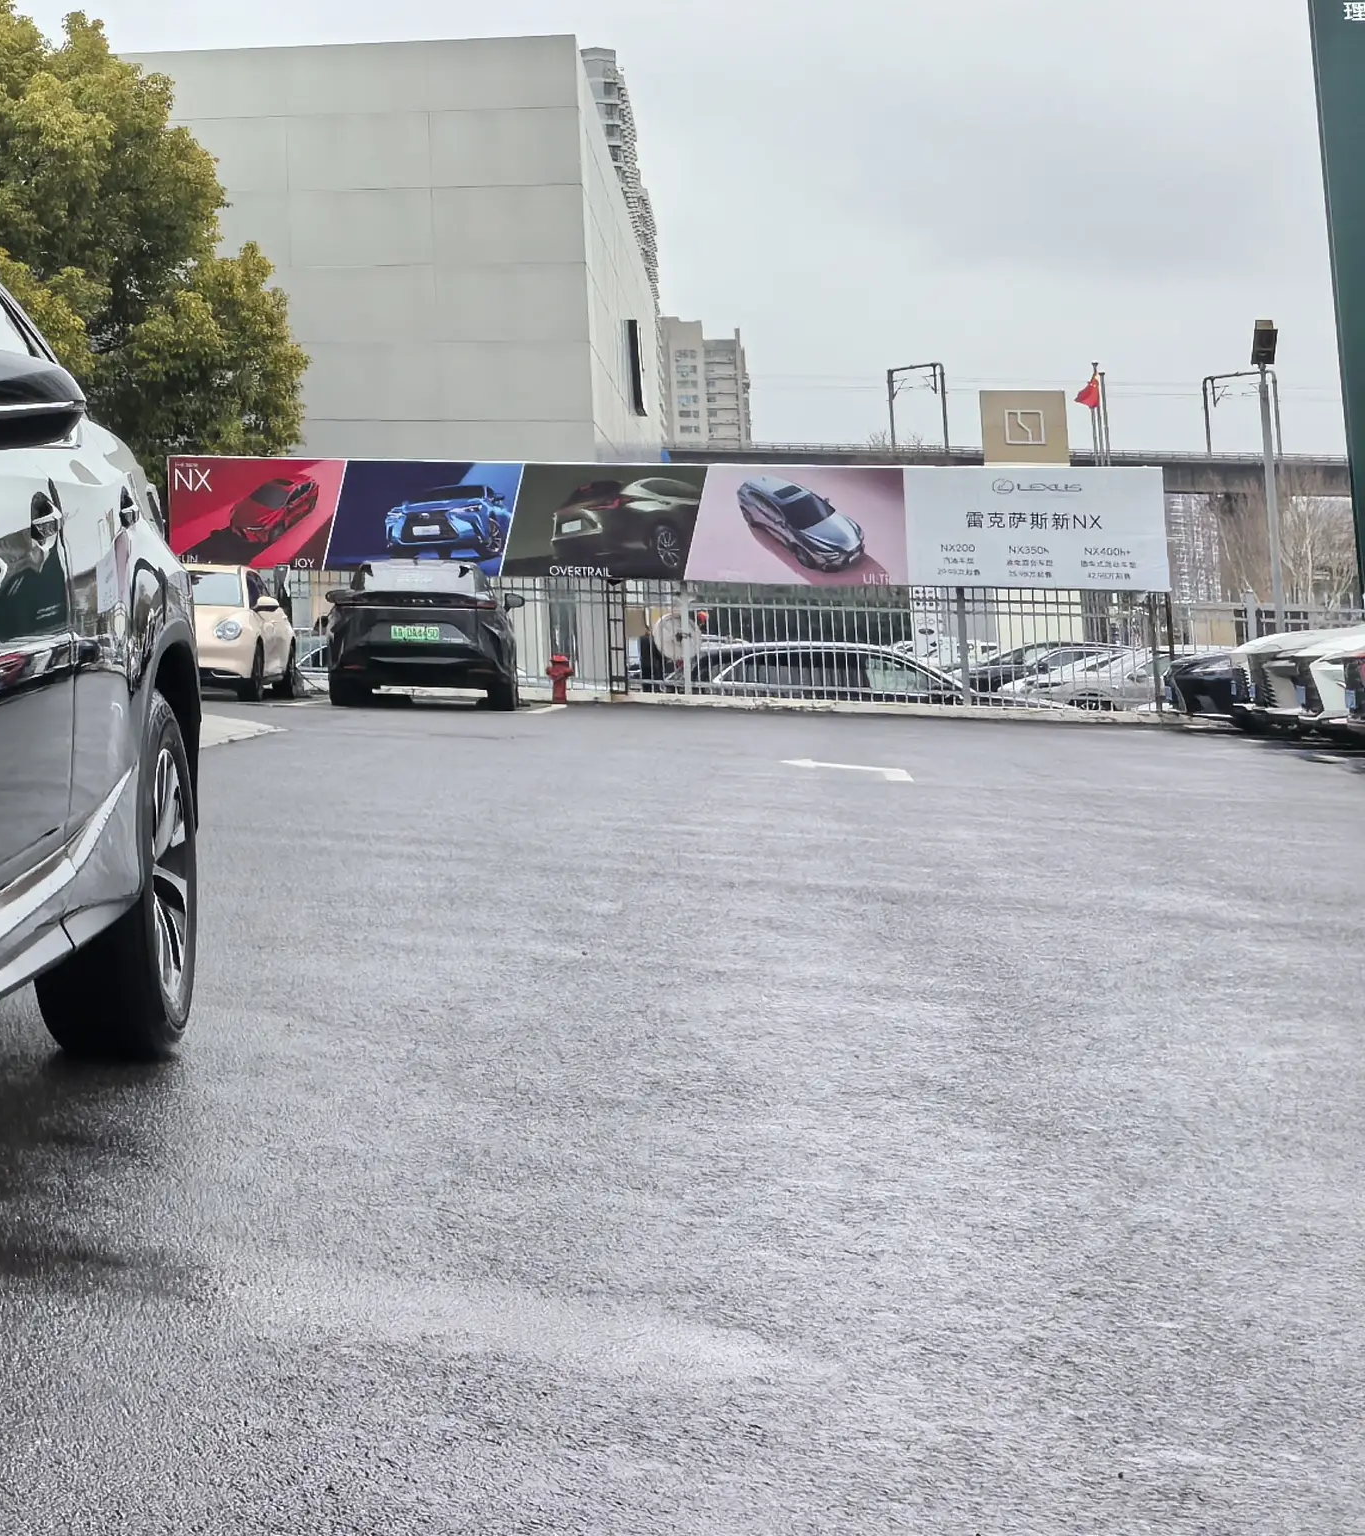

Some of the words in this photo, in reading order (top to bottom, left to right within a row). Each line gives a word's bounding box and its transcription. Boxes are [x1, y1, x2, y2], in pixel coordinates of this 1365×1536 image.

[174, 468, 212, 492] NX
[966, 511, 1103, 530] 雷克萨斯新NX
[940, 543, 976, 553] NX200
[293, 558, 315, 568] JOY
[549, 565, 613, 577] OVERTRAIL
